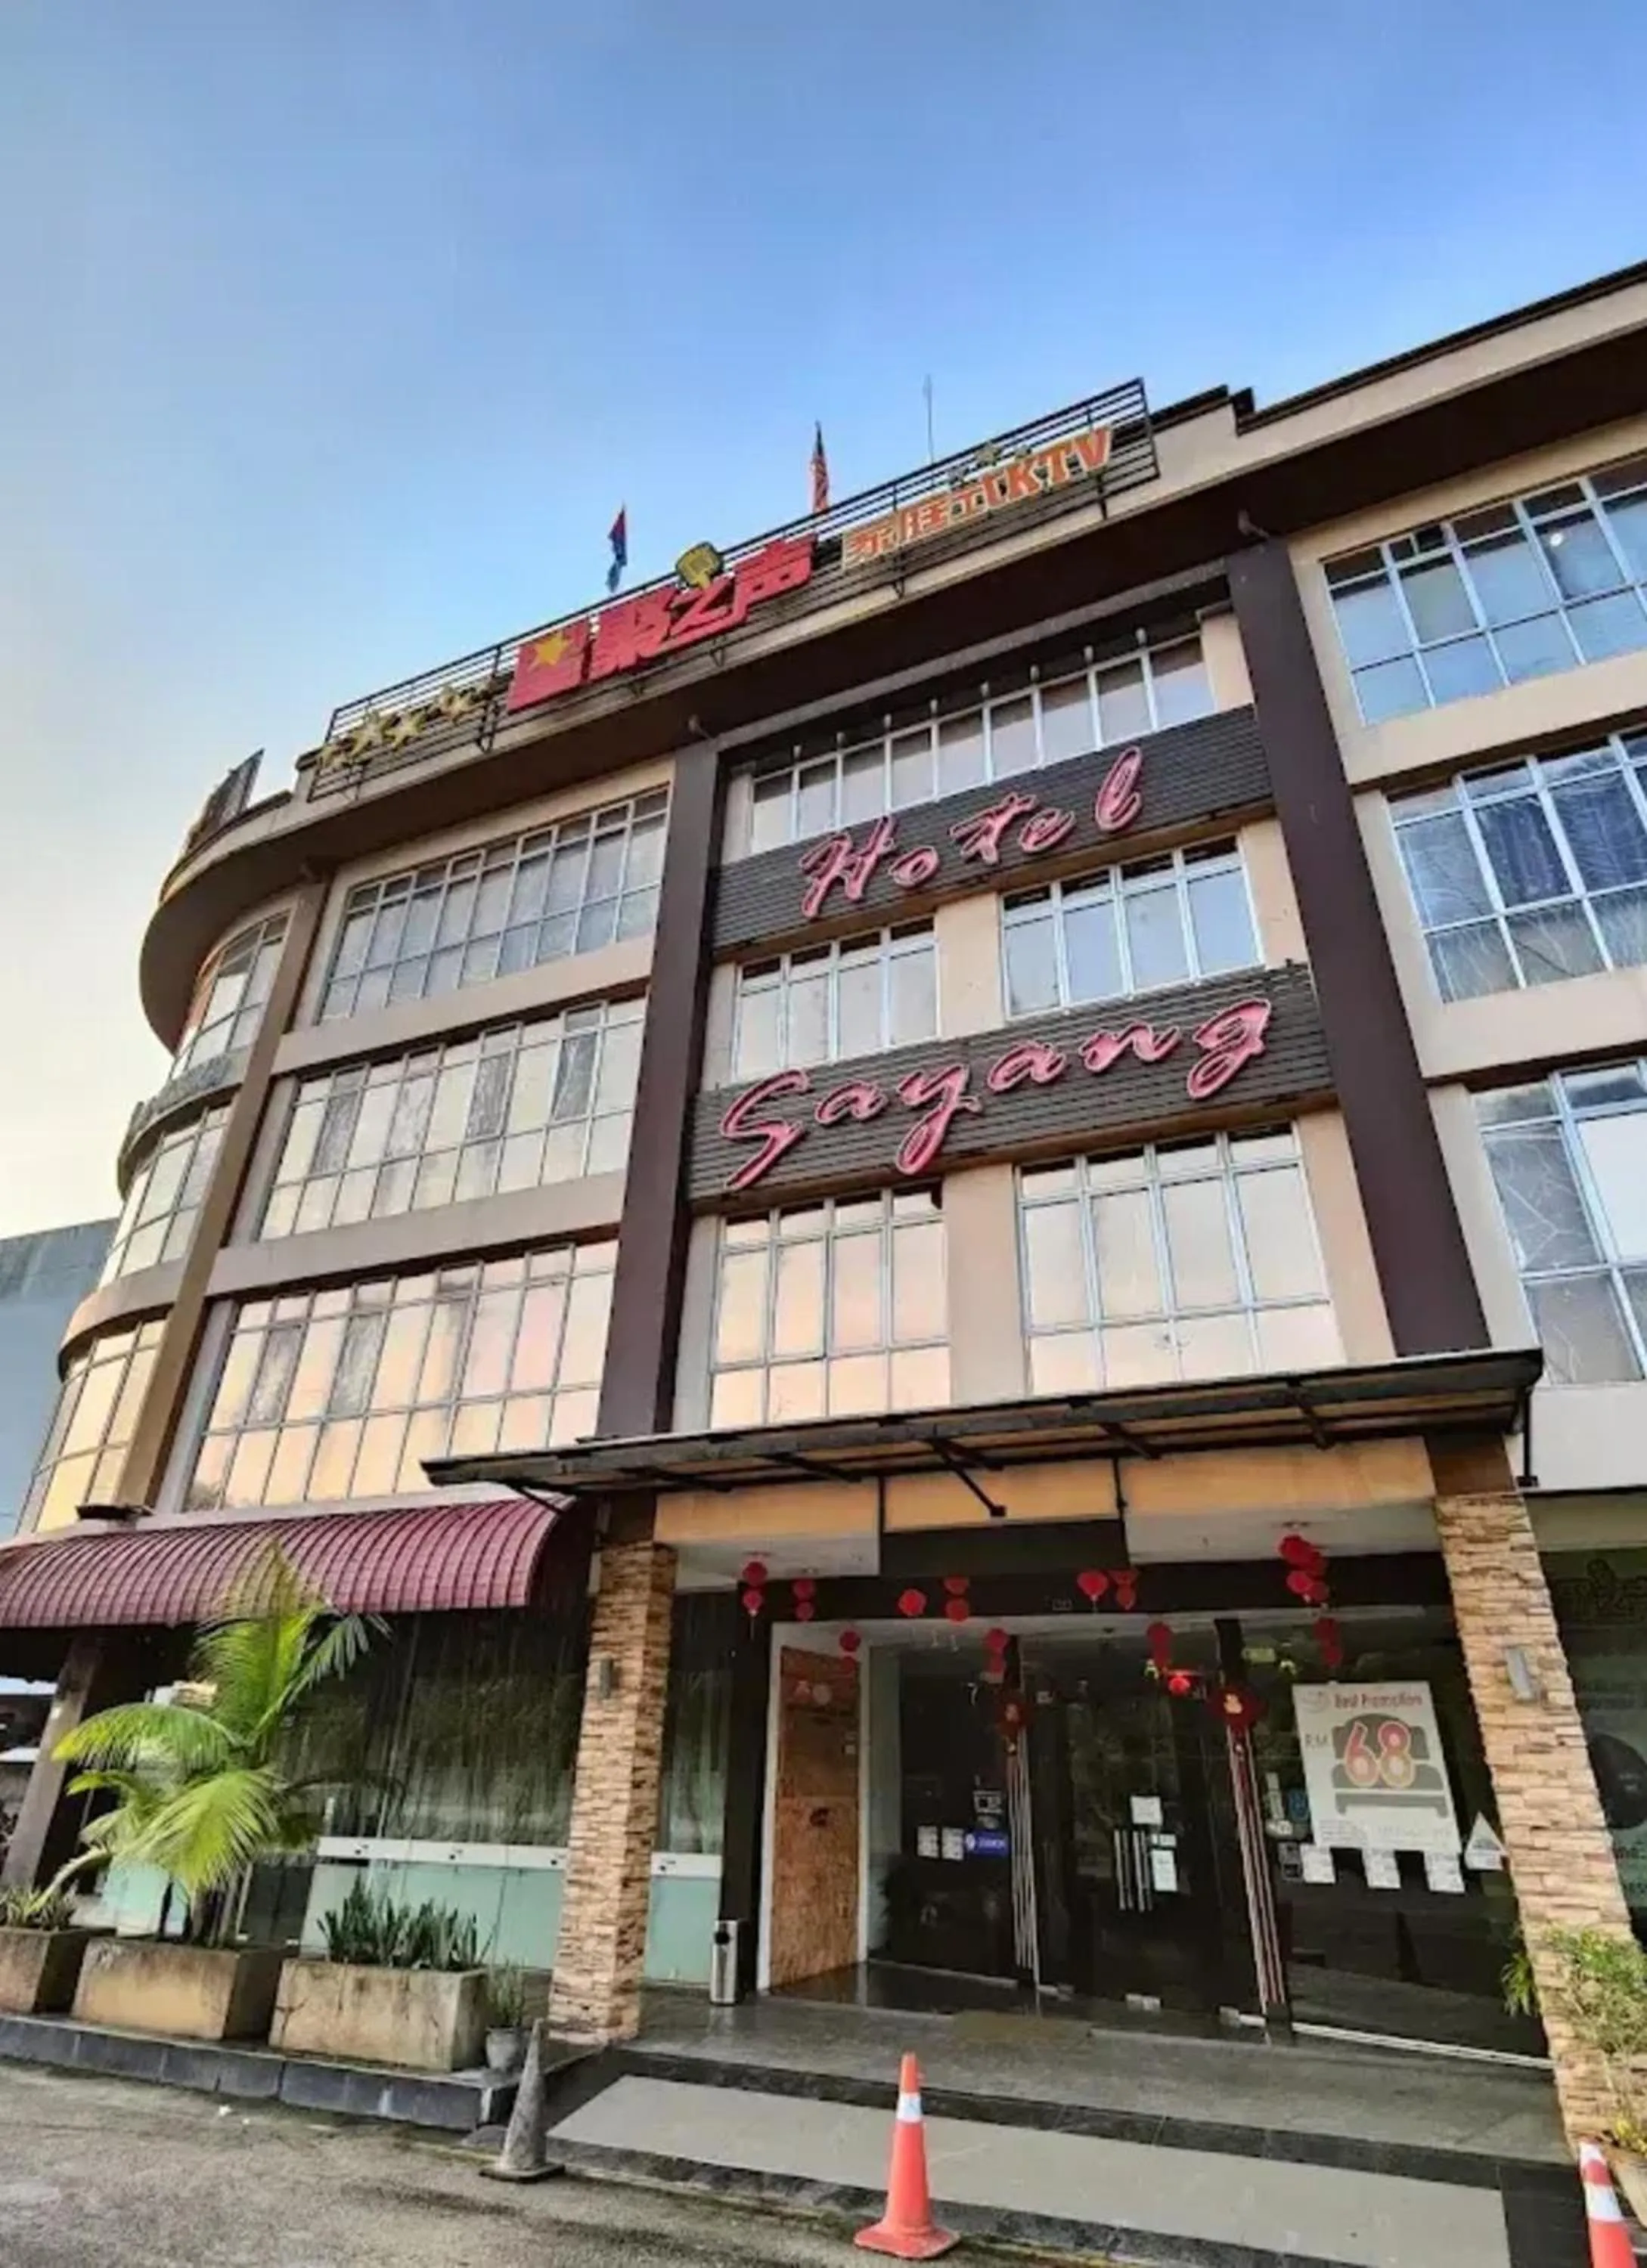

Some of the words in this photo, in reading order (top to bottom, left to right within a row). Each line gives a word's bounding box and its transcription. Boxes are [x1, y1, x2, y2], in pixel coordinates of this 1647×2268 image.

[800, 746, 1143, 919] Hotel
[719, 998, 1272, 1191] Sayang
[1343, 1720, 1416, 1789] 68
